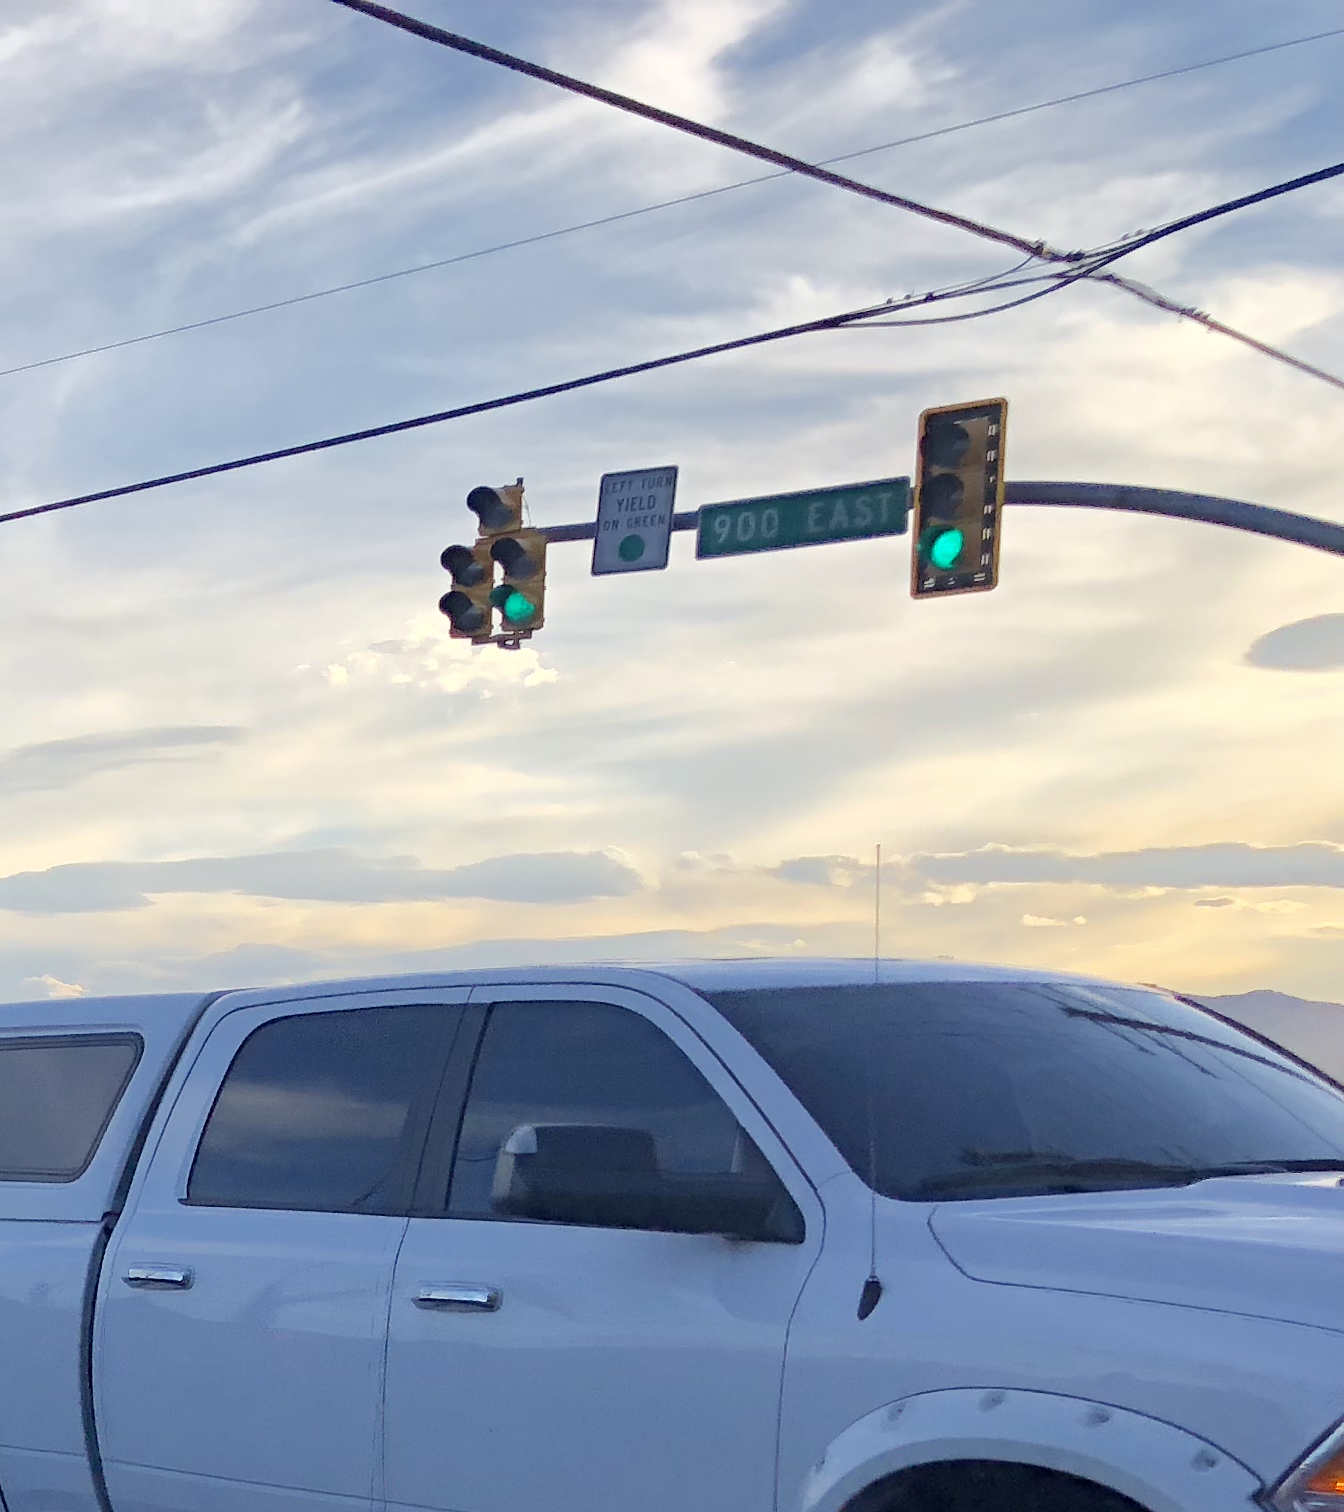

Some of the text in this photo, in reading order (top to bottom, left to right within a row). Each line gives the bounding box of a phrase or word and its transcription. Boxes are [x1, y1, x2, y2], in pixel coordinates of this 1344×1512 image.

[641, 475, 673, 490] TURN
[617, 494, 657, 512] YIELD
[603, 513, 665, 532] ON GREEN
[713, 491, 893, 544] 900 EAST
